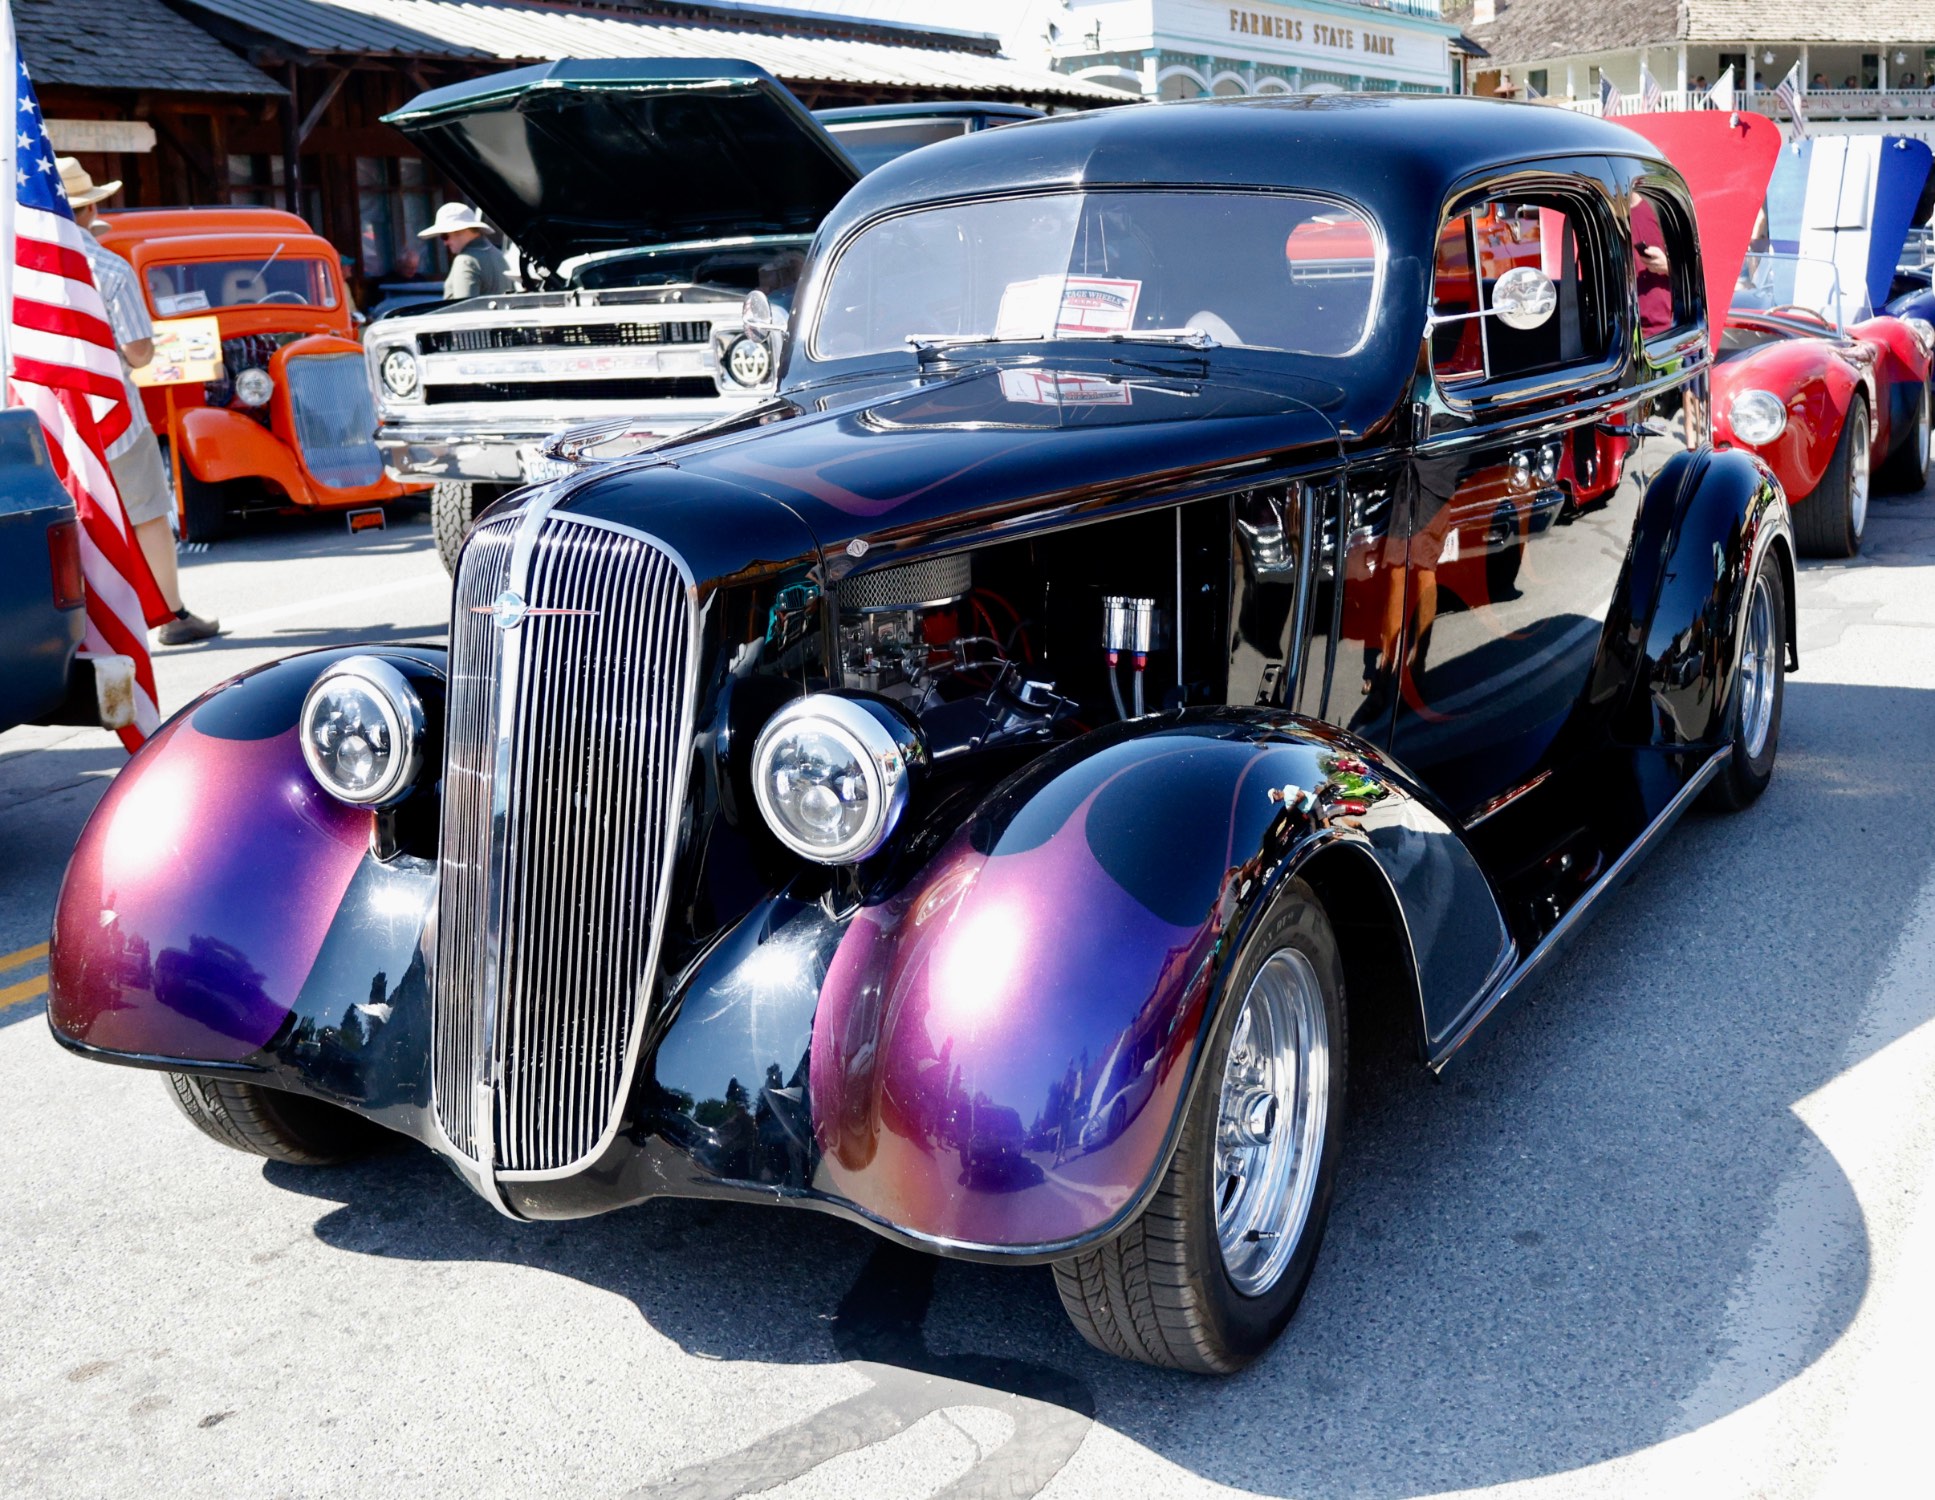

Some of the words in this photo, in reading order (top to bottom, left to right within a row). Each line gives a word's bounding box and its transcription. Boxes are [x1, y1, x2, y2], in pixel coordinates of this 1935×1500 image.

[1230, 9, 1303, 42] FARMERS
[1313, 24, 1354, 49] STATE
[1363, 33, 1395, 56] BANK
[1088, 291, 1123, 305] WHEELS
